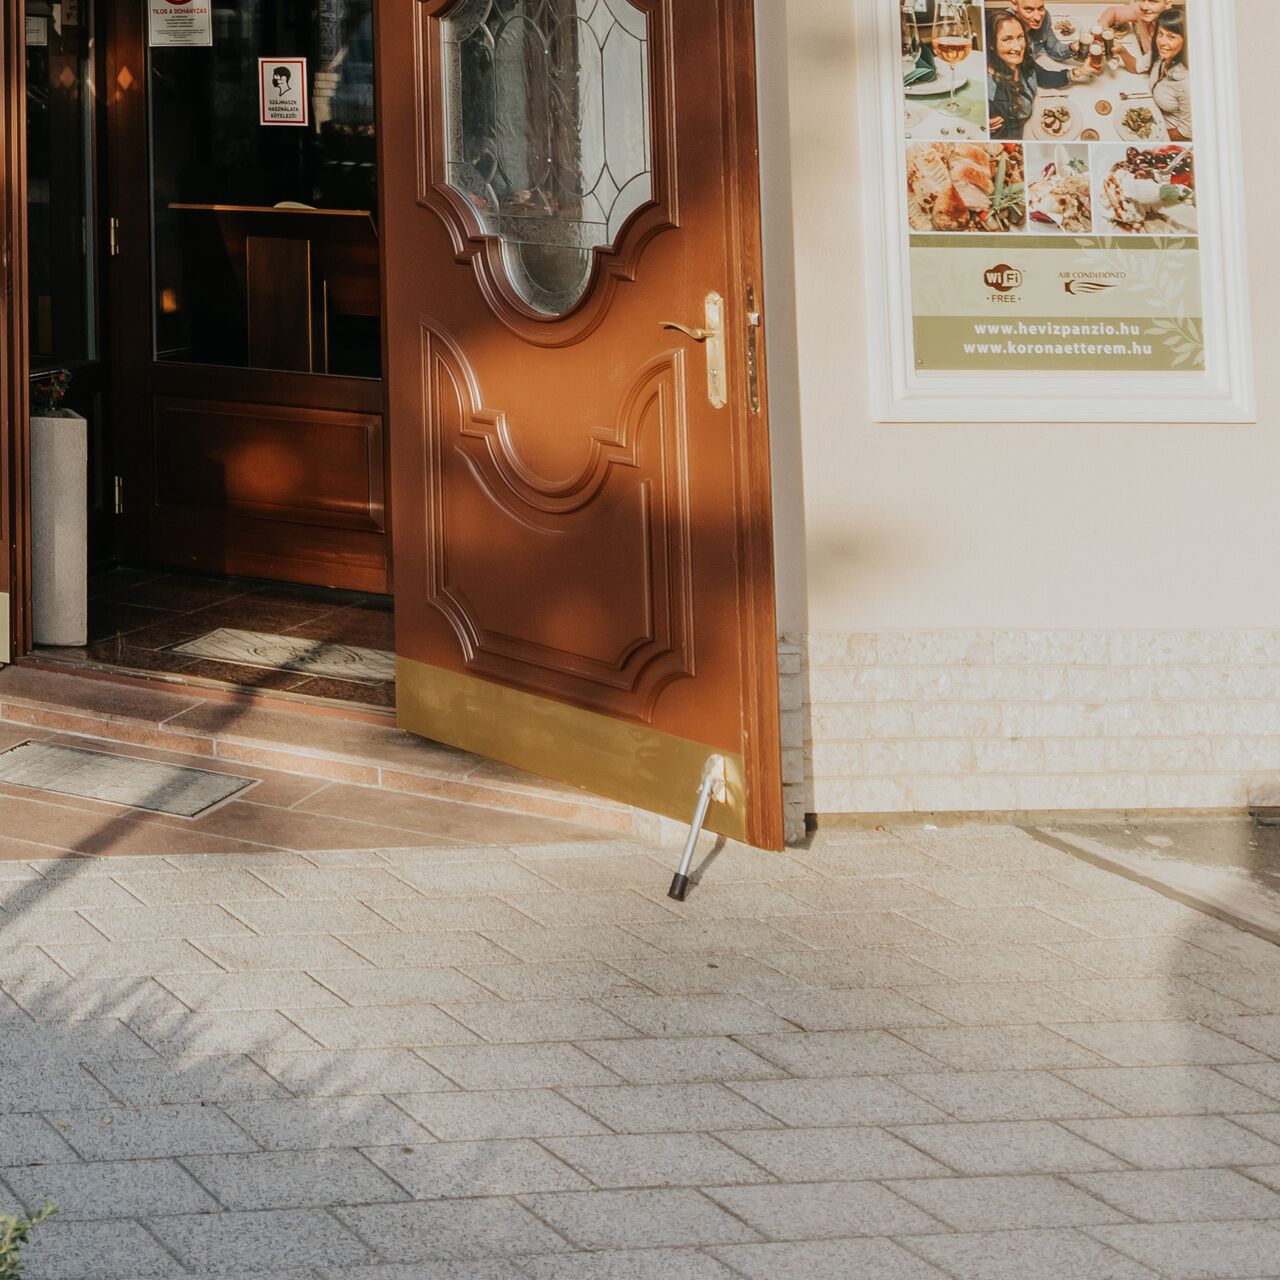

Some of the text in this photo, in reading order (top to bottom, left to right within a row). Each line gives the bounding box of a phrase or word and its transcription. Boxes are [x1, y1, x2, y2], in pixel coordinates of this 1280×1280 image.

[174, 7, 208, 15] DOHÁNYZÁS
[1058, 271, 1127, 279] AIR CONDITIONED
[991, 294, 1017, 303] FREE
[974, 321, 1140, 338] www.hevizpanzio.hu
[963, 341, 1152, 355] www.koronaetterem.hu
